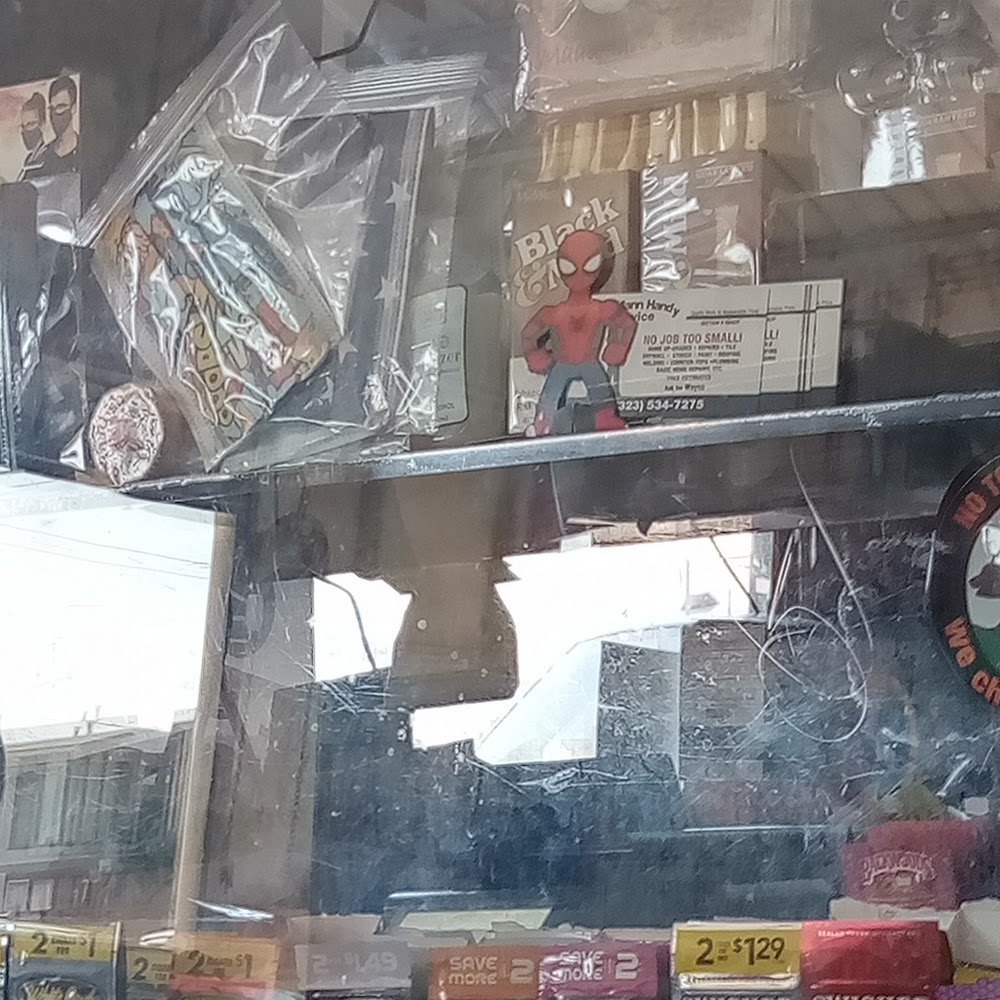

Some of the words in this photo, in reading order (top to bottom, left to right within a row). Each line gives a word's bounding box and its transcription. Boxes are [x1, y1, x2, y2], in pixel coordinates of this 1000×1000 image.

[514, 197, 620, 266] Black
[646, 299, 680, 318] Handy
[643, 334, 657, 345] NO
[660, 333, 679, 345] JOB
[682, 333, 702, 344] TOO
[646, 398, 705, 411] 534-7275
[29, 933, 49, 955] 2
[695, 937, 715, 966] 2
[131, 957, 149, 981] 2
[187, 950, 205, 975] 2
[510, 958, 534, 984] 2
[615, 952, 639, 980] 2
